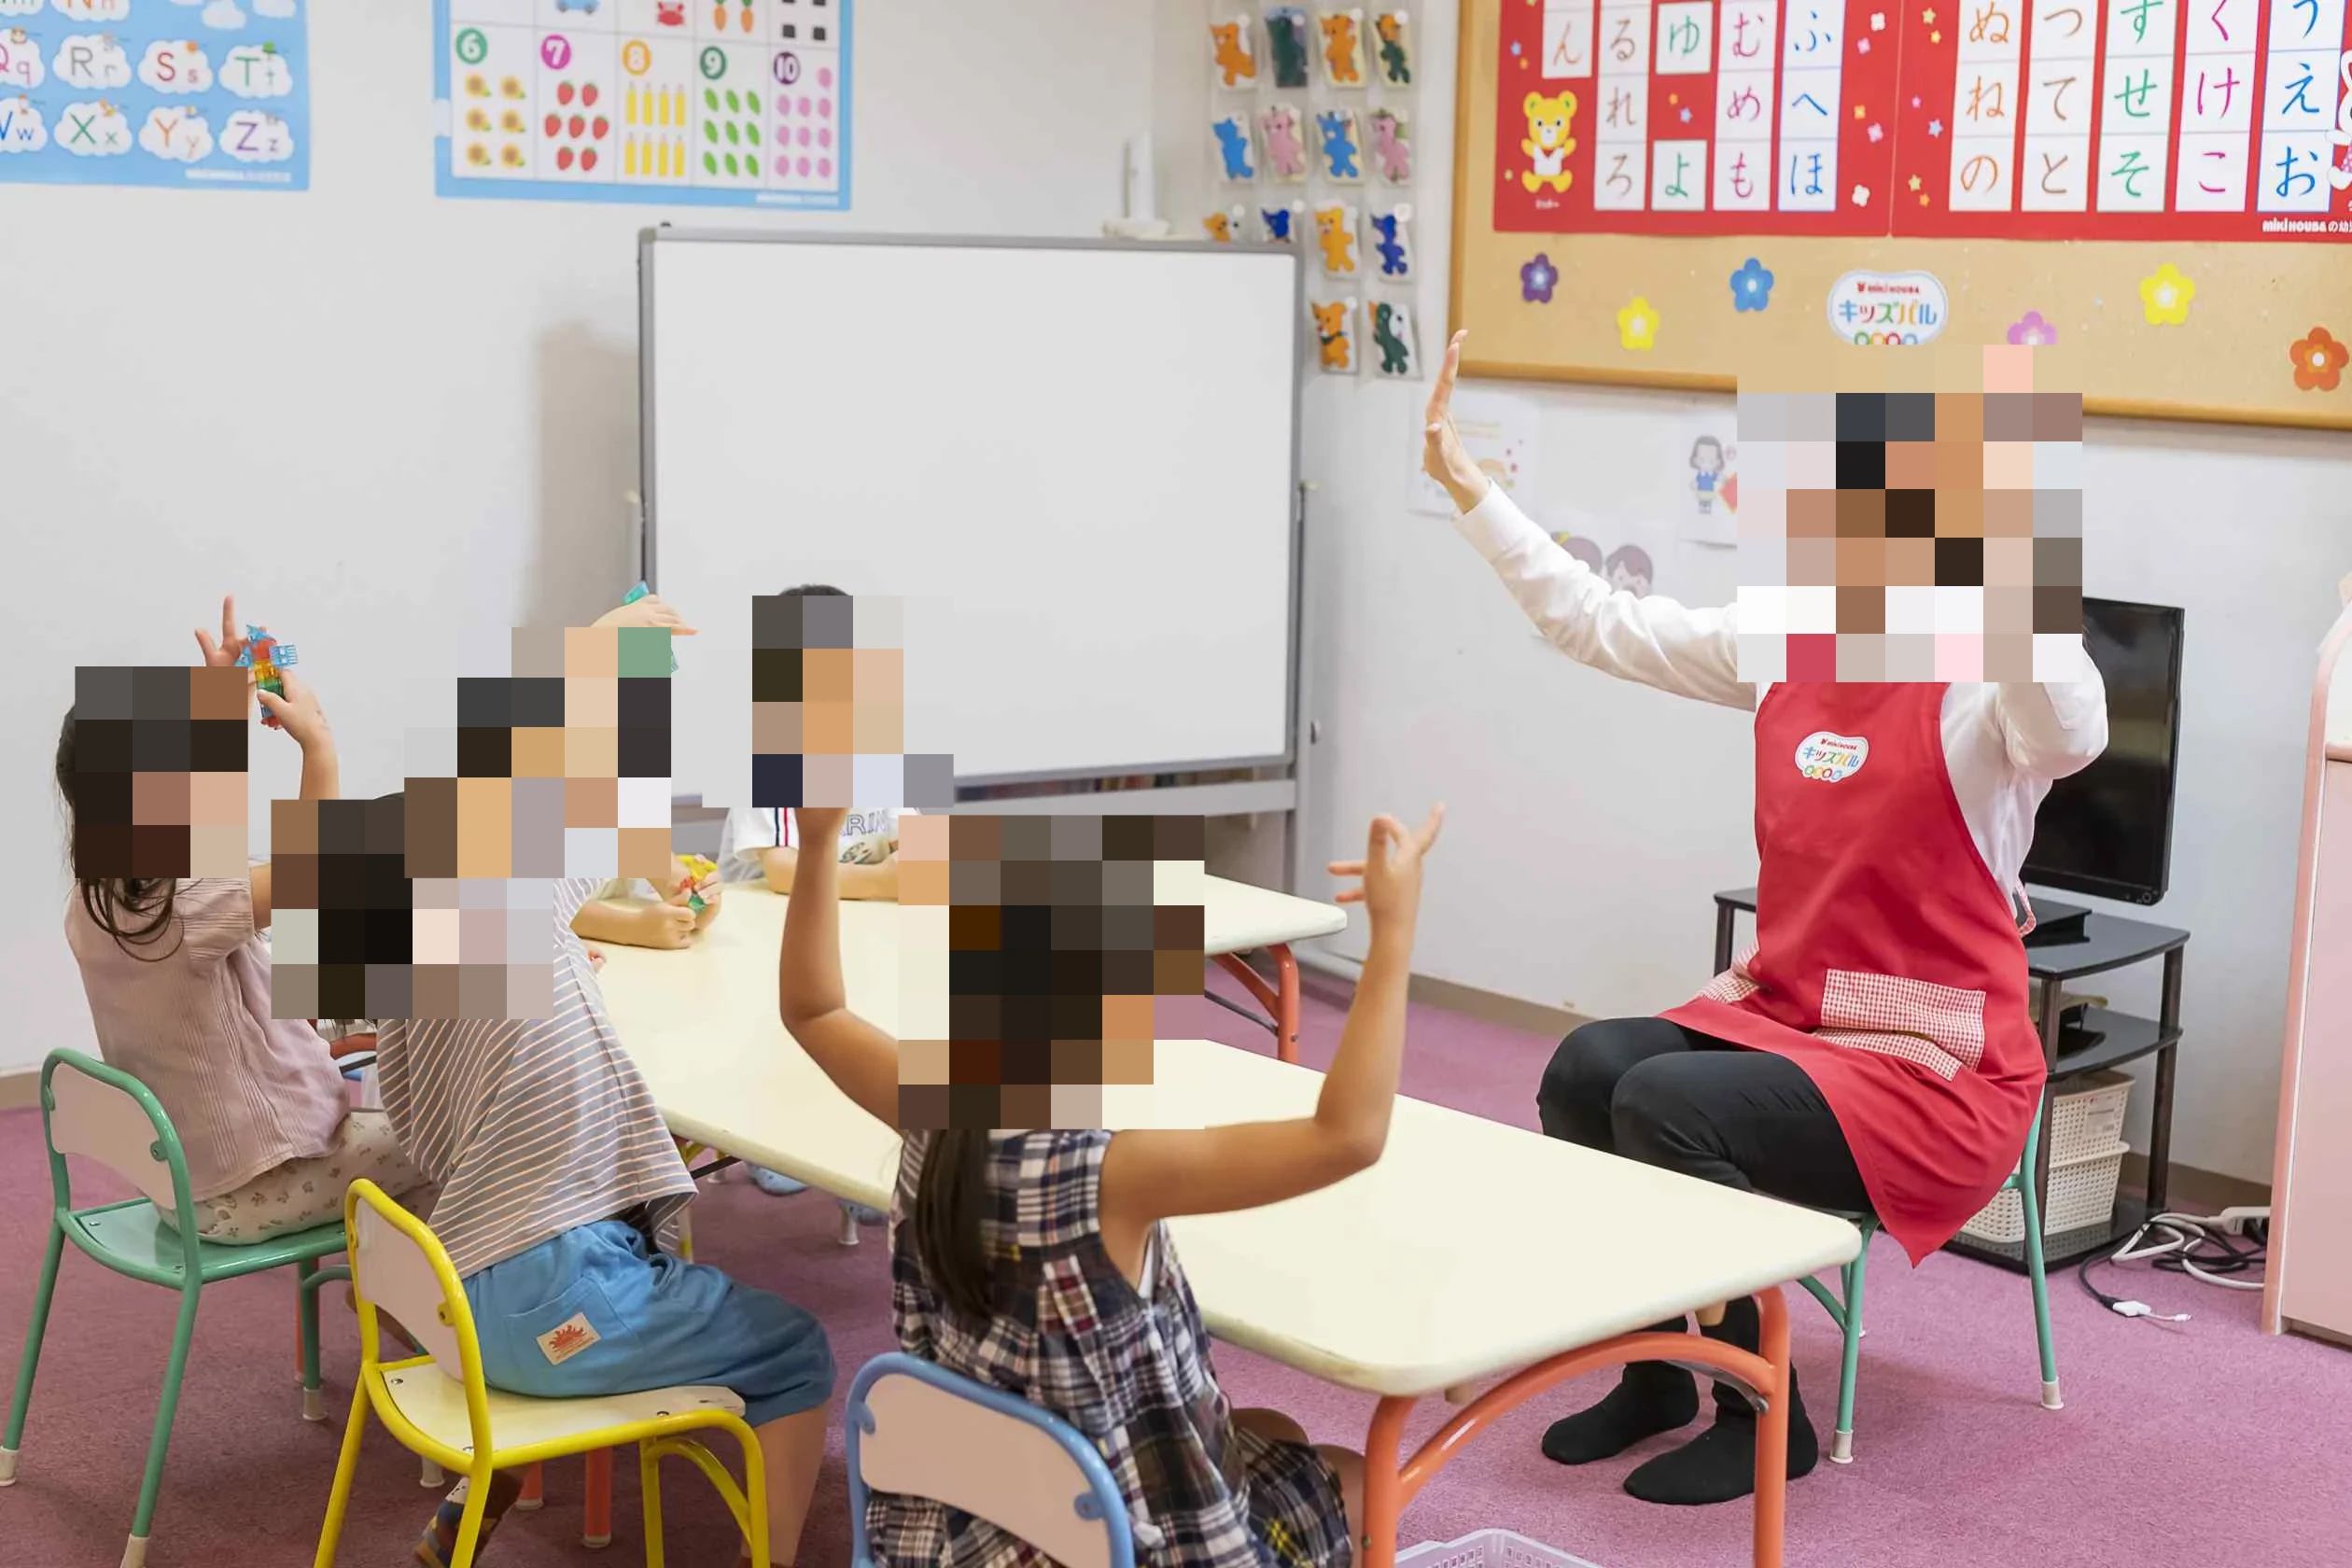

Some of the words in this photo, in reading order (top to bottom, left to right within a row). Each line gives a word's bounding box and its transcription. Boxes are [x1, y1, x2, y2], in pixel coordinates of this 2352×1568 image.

[1611, 20, 1634, 60] る
[1669, 15, 1700, 58] ゆ
[1733, 13, 1763, 57] む
[1794, 11, 1831, 51] ふ
[1969, 1, 2009, 43] ぬ
[2044, 8, 2082, 35] つ
[2121, 0, 2163, 43] す
[2211, 0, 2229, 41] く
[1553, 21, 1581, 64] ん
[1606, 87, 1636, 128] れ
[1727, 86, 1760, 121] め
[1792, 93, 1827, 116] へ
[1967, 77, 2004, 120] ね
[2043, 77, 2076, 120] て
[2114, 69, 2157, 118] せ
[2197, 67, 2240, 118] け
[2282, 63, 2320, 115] え
[1605, 154, 1631, 196] ろ
[1665, 154, 1689, 197] よ
[1731, 152, 1753, 198] も
[1791, 153, 1823, 195] ほ
[1961, 156, 1998, 191] の
[2042, 153, 2067, 194] と
[2111, 151, 2149, 198] そ
[2199, 151, 2226, 194] こ
[2275, 146, 2318, 198] お
